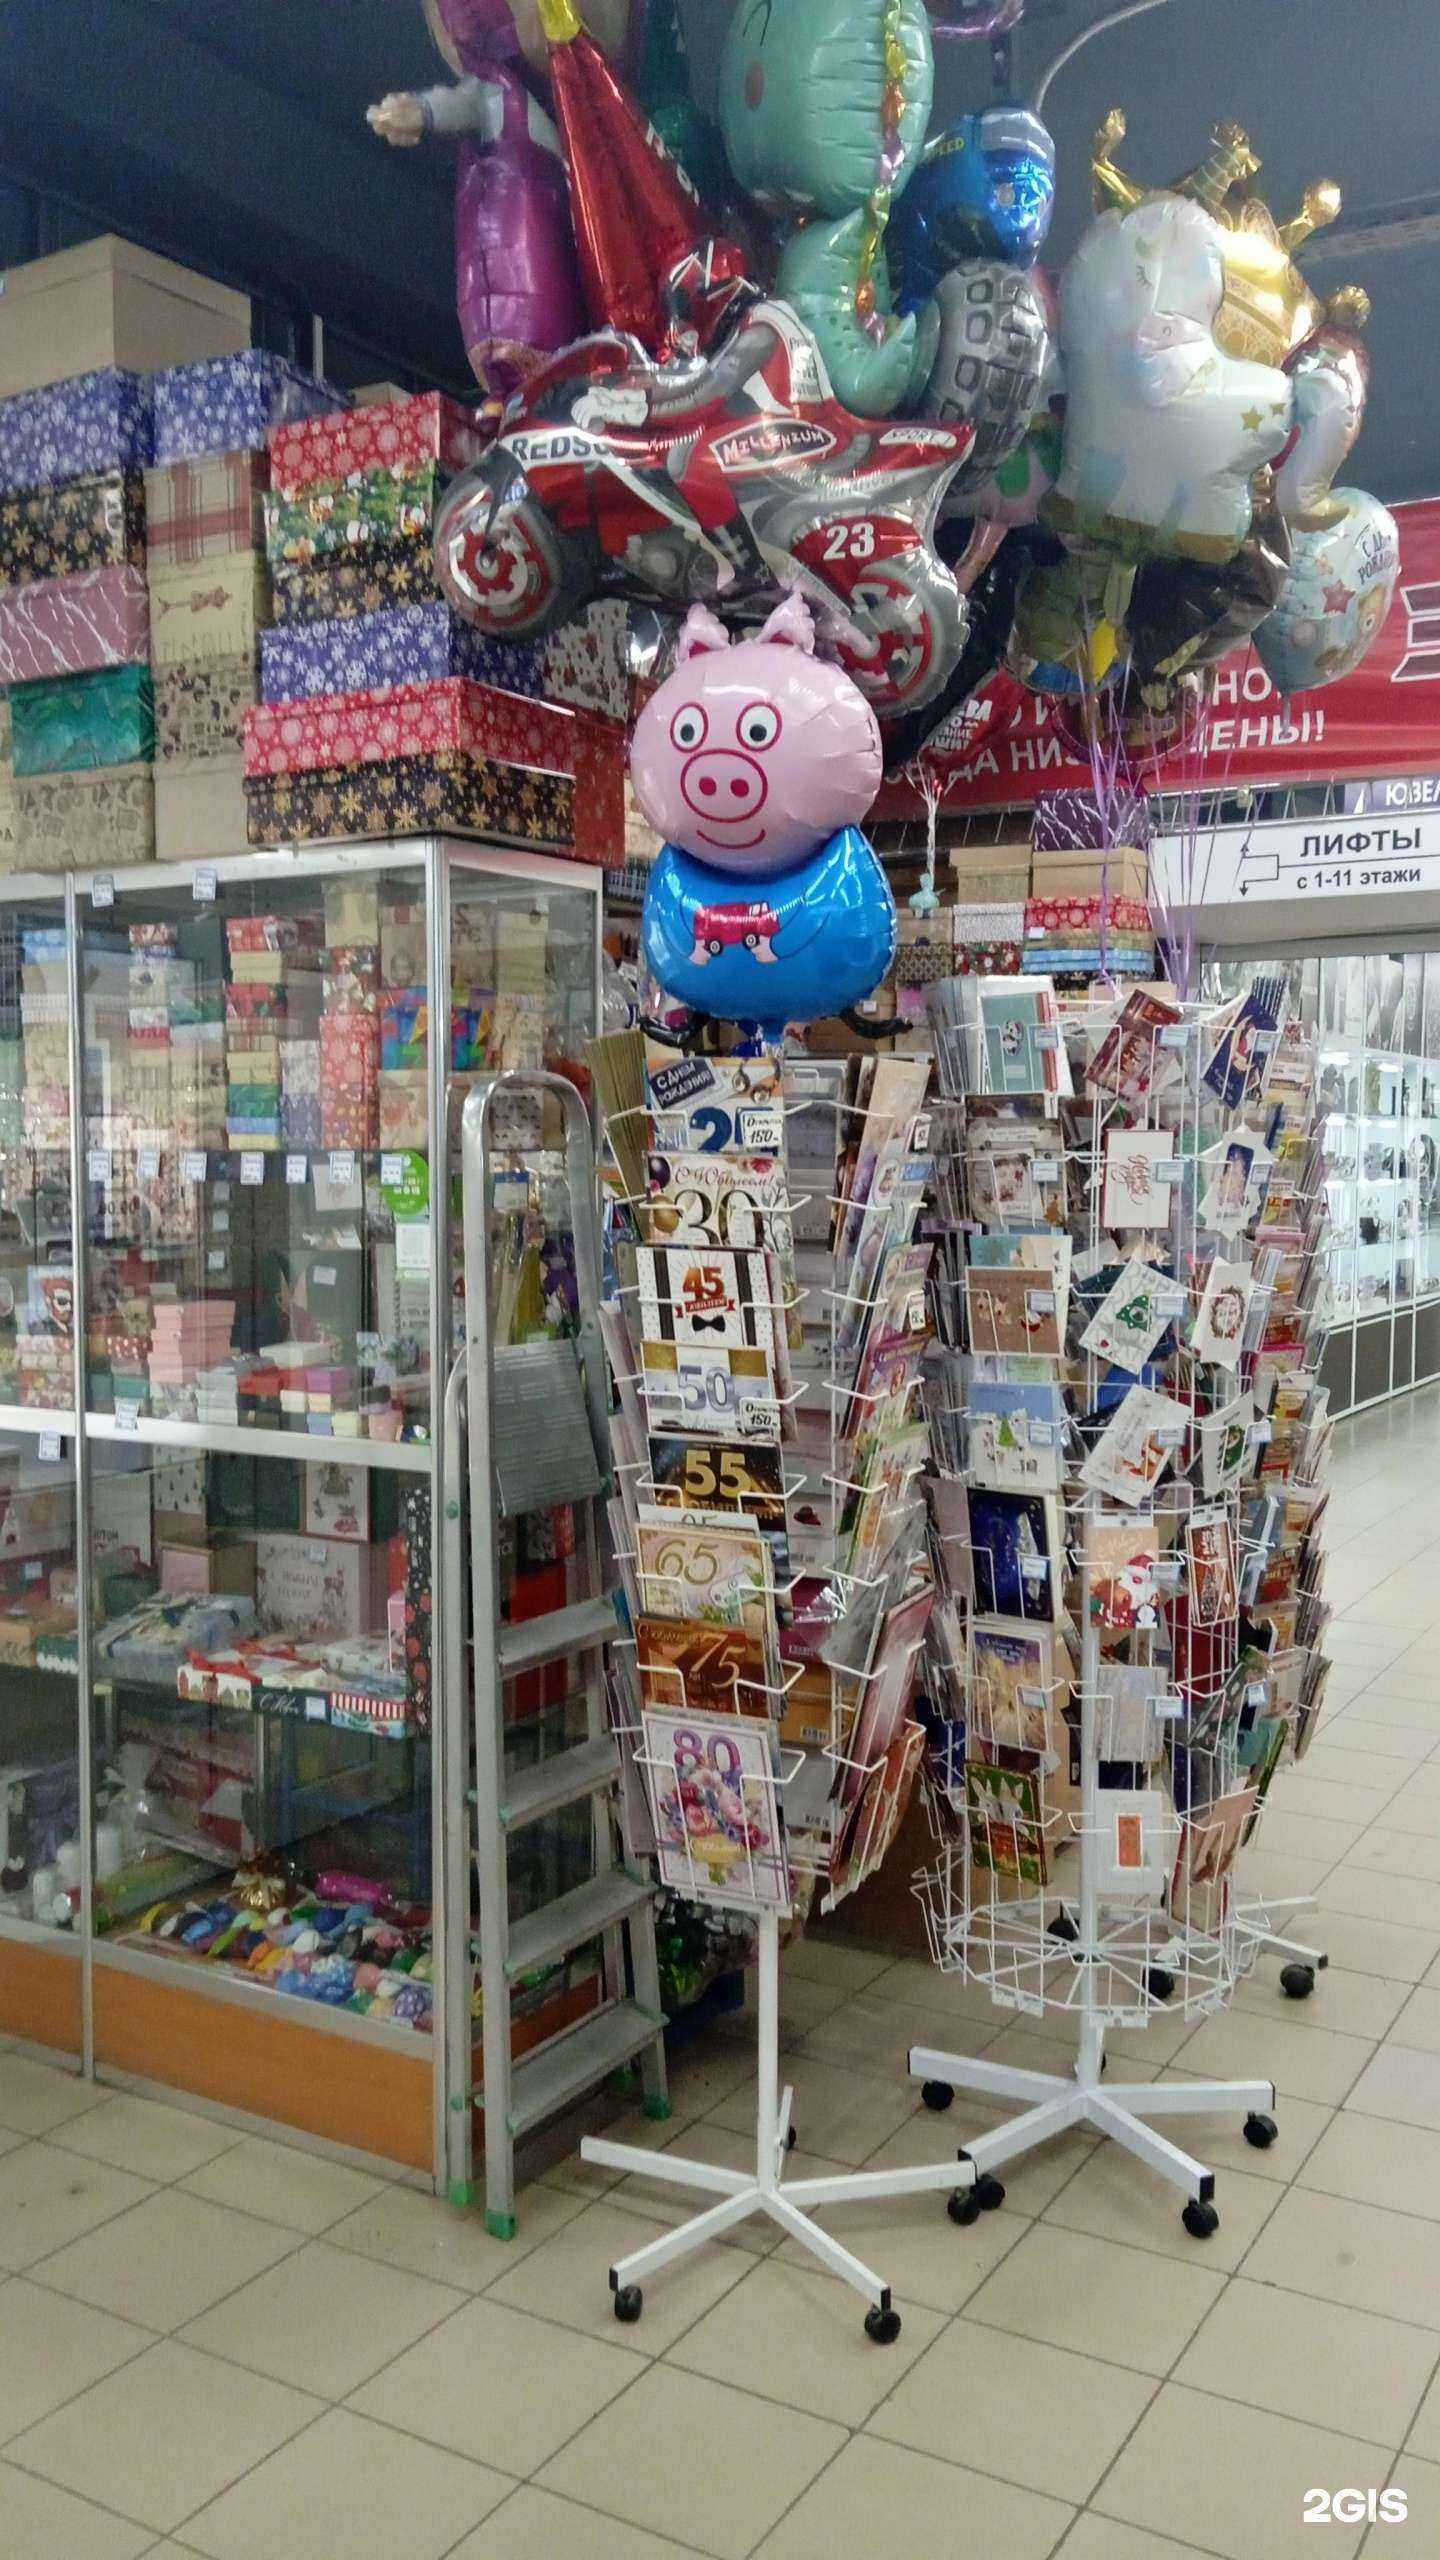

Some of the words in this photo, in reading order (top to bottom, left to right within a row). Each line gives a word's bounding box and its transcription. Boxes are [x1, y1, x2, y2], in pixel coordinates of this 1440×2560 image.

[822, 521, 876, 562] 23
[1300, 828, 1420, 857] ЛИФТЫ
[1297, 876, 1308, 889] с
[1315, 869, 1352, 888] 1-11
[1360, 868, 1421, 885] этажи
[682, 1266, 725, 1301] 45
[679, 1364, 737, 1413] 50
[685, 1449, 753, 1498] 55
[655, 1538, 720, 1585] 65
[691, 1634, 746, 1689] 75
[673, 1728, 742, 1780] 80
